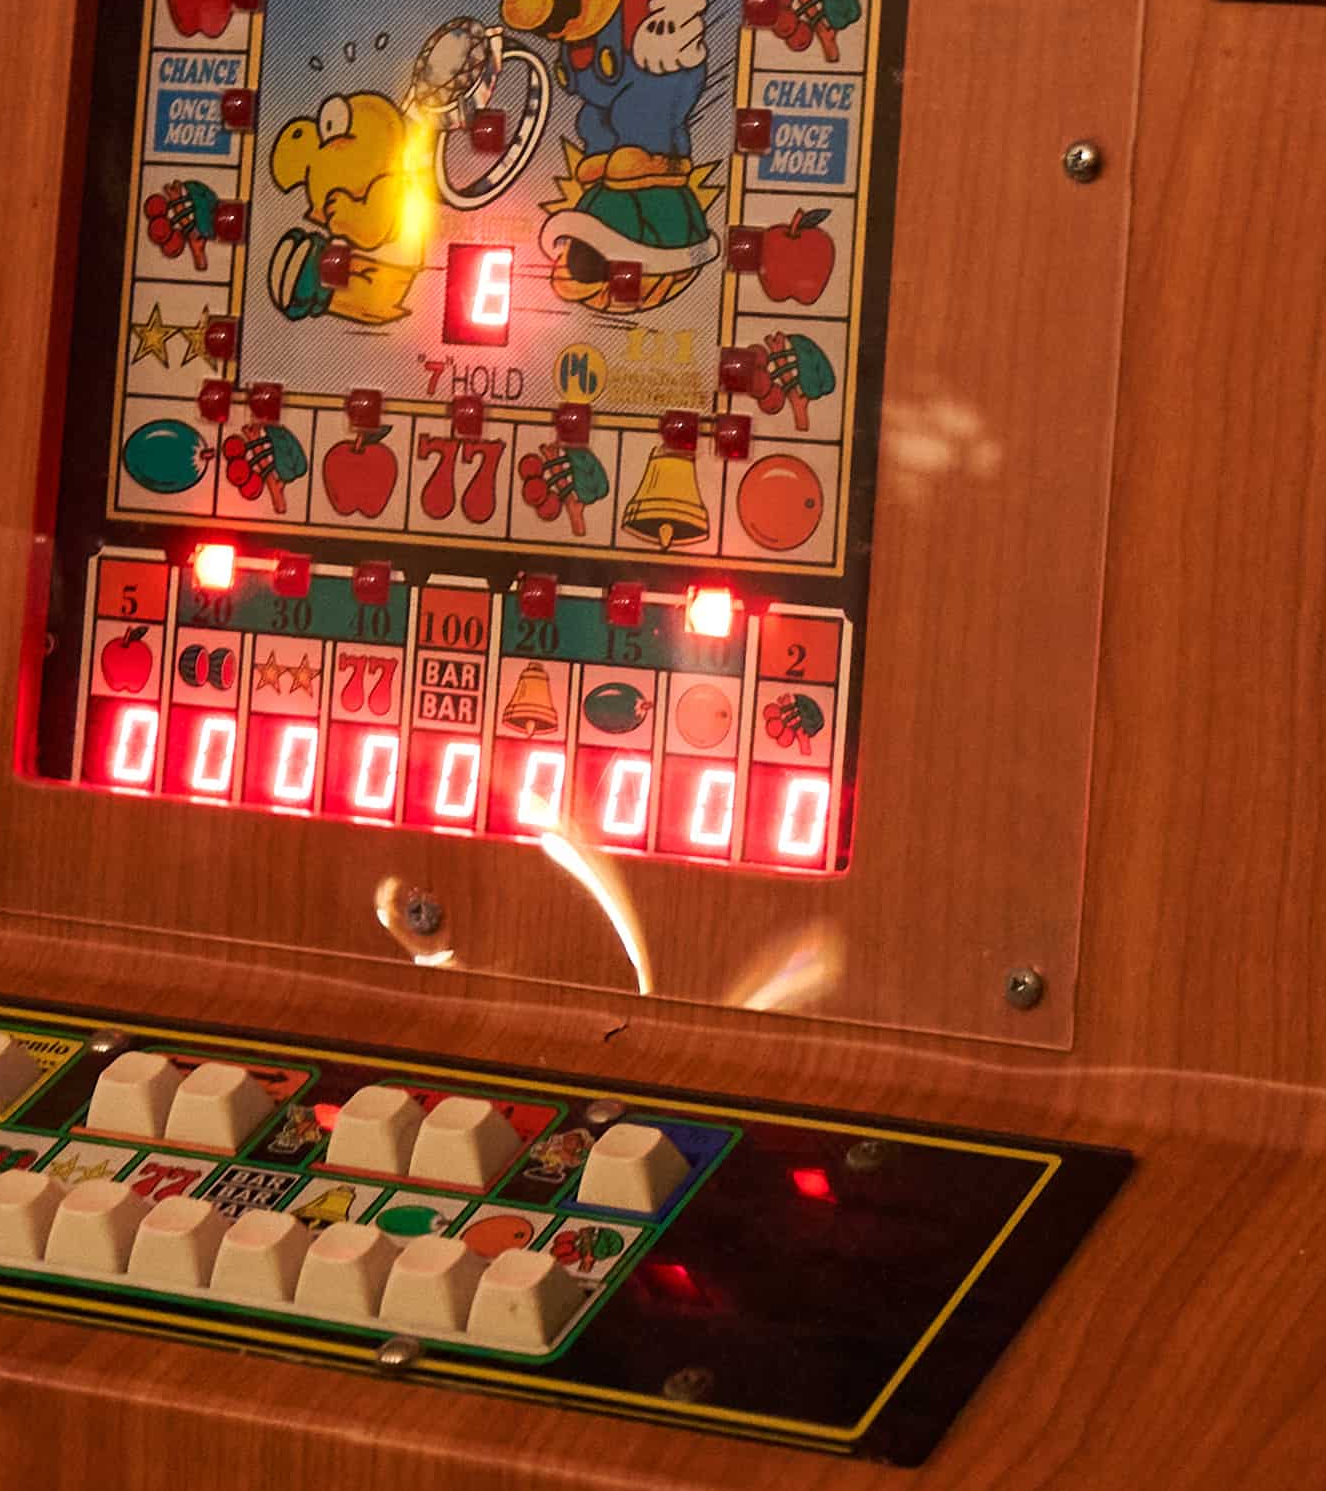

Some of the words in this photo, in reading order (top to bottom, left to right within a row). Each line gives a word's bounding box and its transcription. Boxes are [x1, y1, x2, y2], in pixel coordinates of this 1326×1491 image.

[159, 56, 242, 85] CHANCE
[169, 97, 223, 122] ONCE
[762, 79, 855, 111] CHANCE
[164, 122, 221, 147] MORE
[775, 122, 834, 149] ONCE
[769, 149, 832, 176] MORE
[471, 250, 513, 326] 6
[452, 365, 525, 402] HOLD
[118, 583, 140, 618] 5
[423, 610, 486, 650] 100
[515, 618, 560, 655] 20
[604, 628, 643, 664] 15
[424, 659, 477, 690] BAR
[786, 642, 807, 677] 2
[423, 691, 475, 722] BAR
[217, 1184, 276, 1205] BAR
[232, 1169, 291, 1192] BAR
